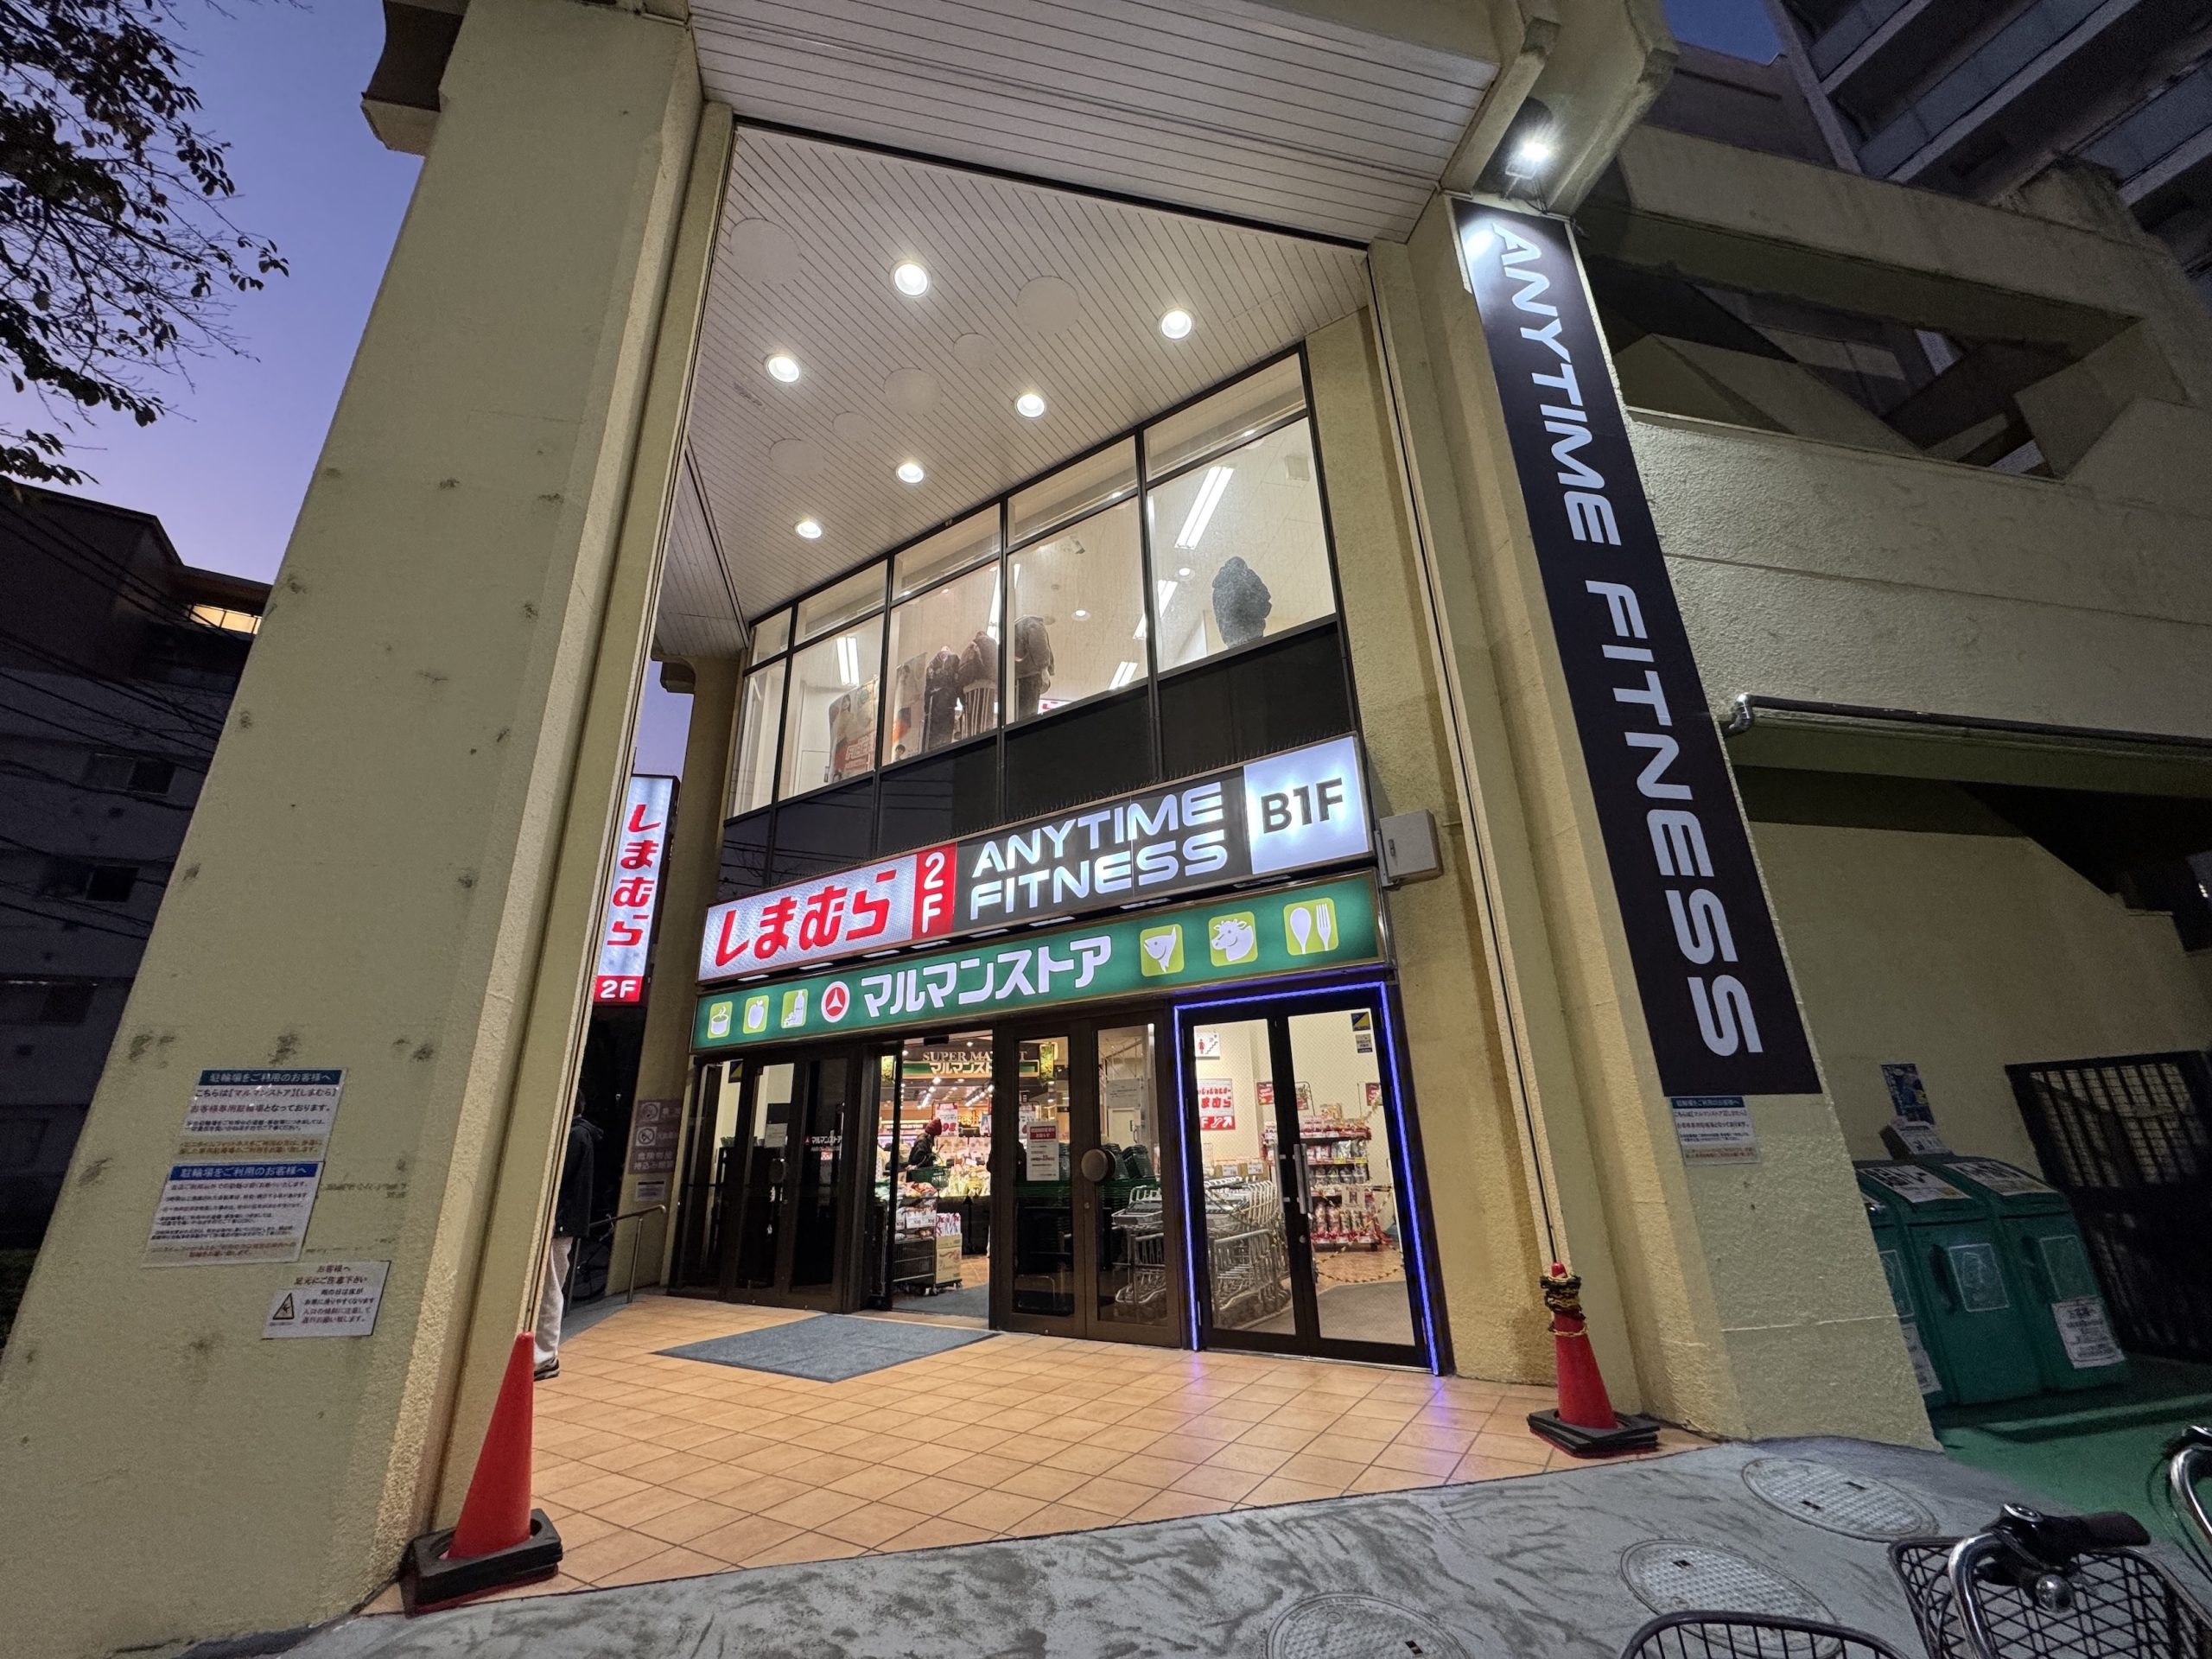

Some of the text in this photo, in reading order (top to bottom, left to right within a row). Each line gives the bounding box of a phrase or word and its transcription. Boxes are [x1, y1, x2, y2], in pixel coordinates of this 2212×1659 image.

[1492, 221, 1622, 547] ANYTIME
[1585, 576, 1764, 1057] FITNESS
[971, 781, 1224, 878] ANYTIME
[1262, 777, 1344, 835] B1F
[606, 803, 661, 947] しまむら
[922, 850, 945, 933] 2F
[969, 828, 1229, 921] FITNESS
[715, 869, 899, 968] しまむら
[600, 979, 637, 1000] 2F
[861, 935, 1112, 1018] マルマンストア
[922, 1051, 967, 1062] SUPER
[930, 1062, 993, 1074] マルマンスト
[179, 1166, 308, 1179] 駐輪場をご利用のお客様へ
